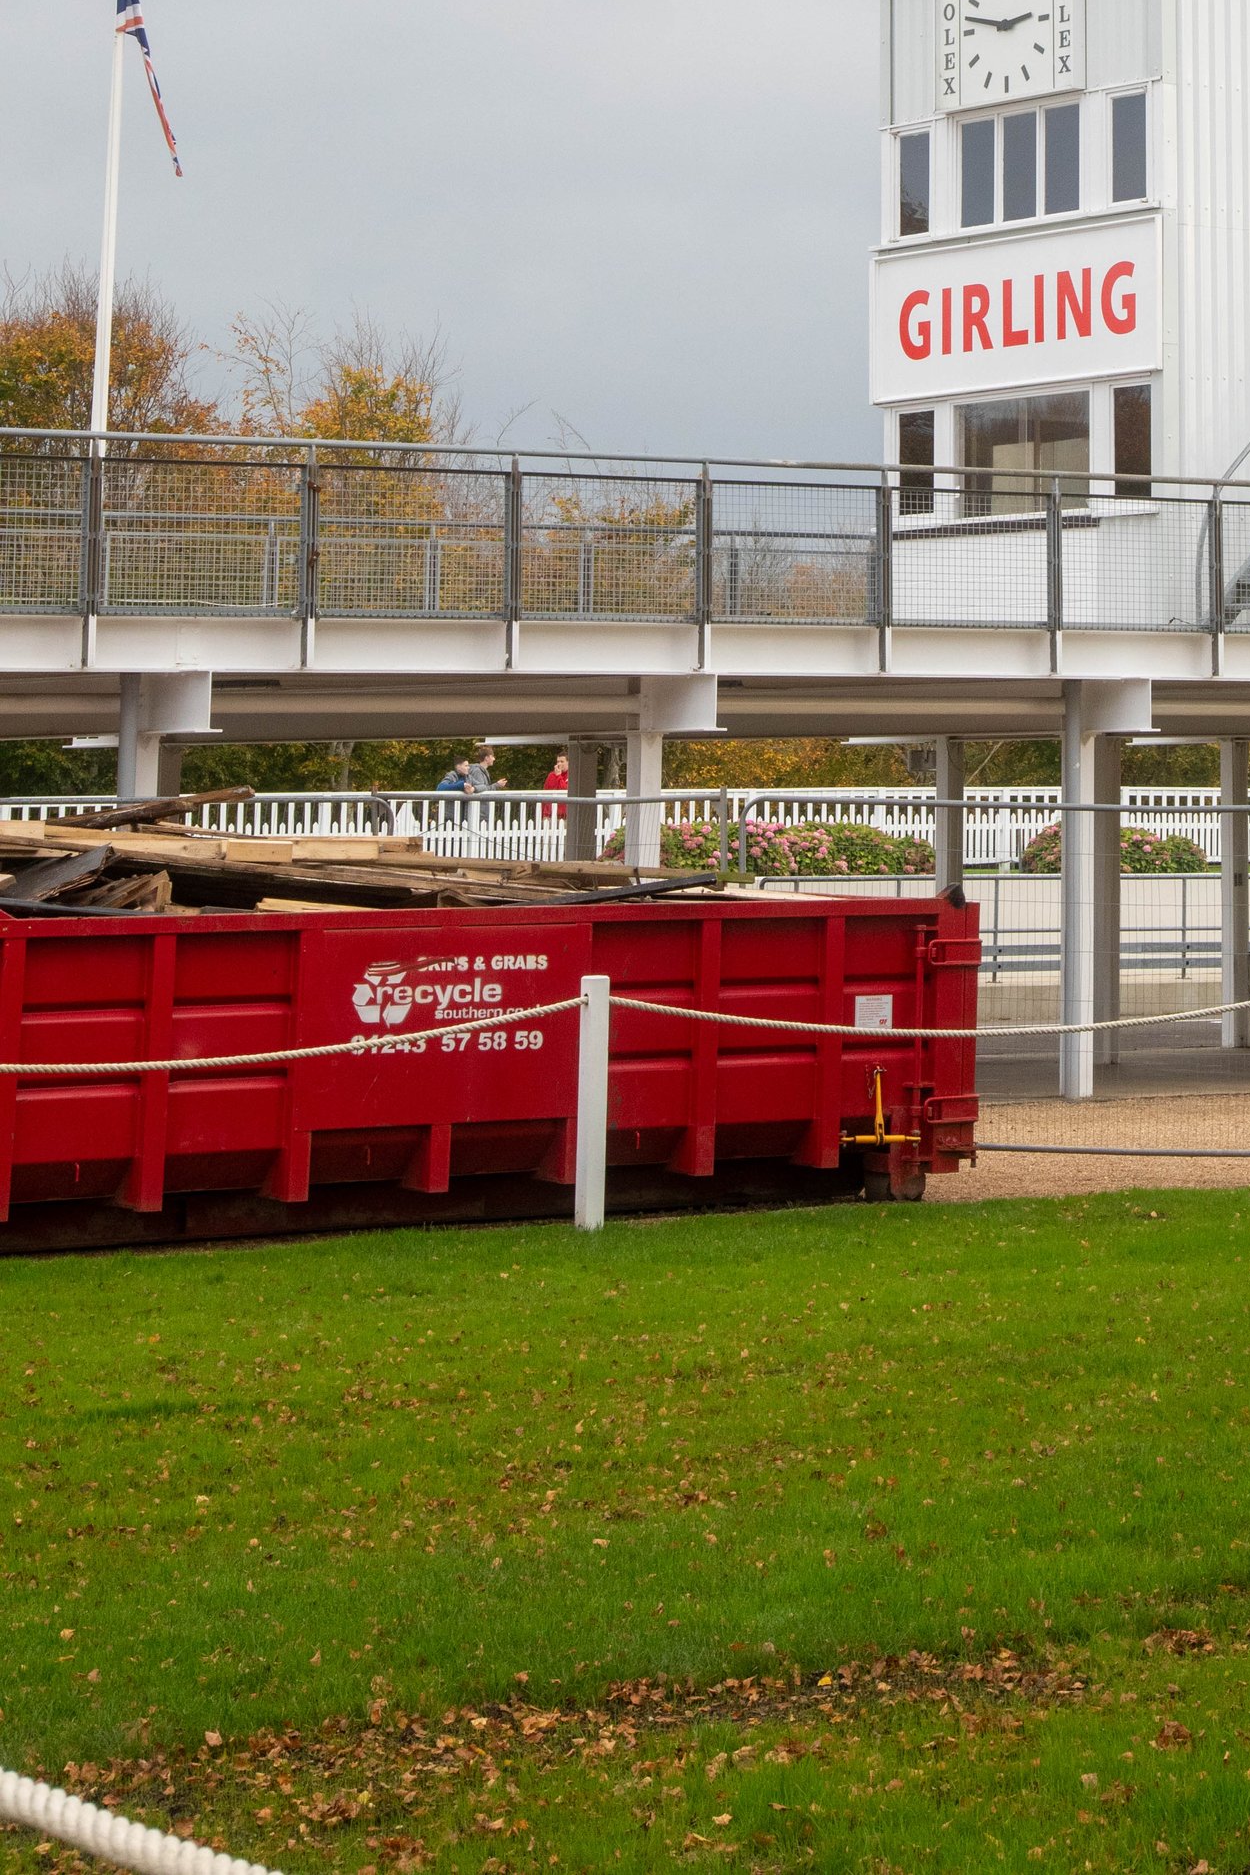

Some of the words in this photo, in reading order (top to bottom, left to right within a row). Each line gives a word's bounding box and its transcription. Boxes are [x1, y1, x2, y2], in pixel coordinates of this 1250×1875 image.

[899, 261, 1137, 361] GIRLING
[473, 957, 486, 970] &
[491, 955, 548, 970] GRABS
[376, 978, 503, 1010] recycle
[441, 1032, 471, 1053] 57
[478, 1032, 507, 1051] 58
[514, 1031, 544, 1050] 59
